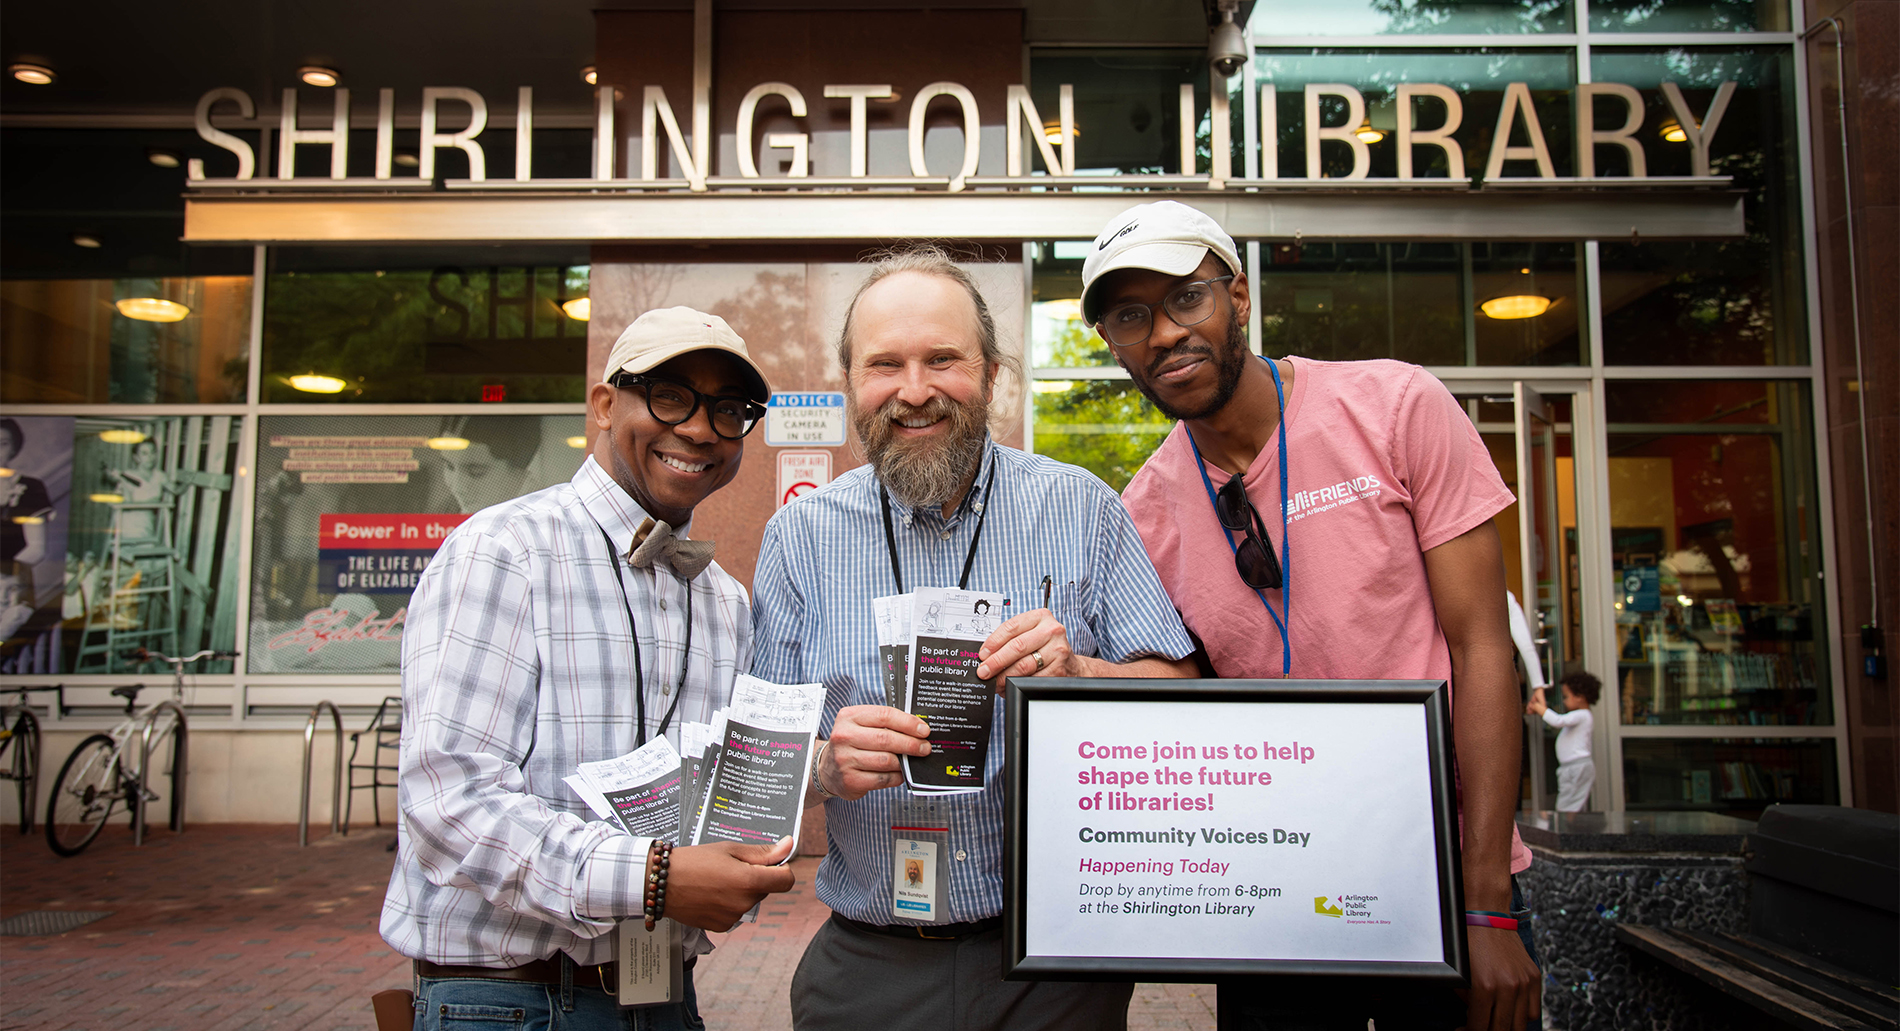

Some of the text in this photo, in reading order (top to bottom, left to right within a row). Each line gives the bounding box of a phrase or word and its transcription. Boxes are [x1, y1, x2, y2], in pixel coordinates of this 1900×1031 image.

[188, 82, 1737, 184] SHIRLINGTON LIBRARY
[776, 395, 834, 406] NOTICE
[781, 409, 830, 418] SECURITY
[784, 421, 827, 429] CAMERA
[787, 432, 823, 440] IN USE
[794, 468, 814, 479] ZONE
[1308, 475, 1381, 506] FRIENDS
[1294, 511, 1305, 521] the
[1306, 502, 1338, 516] Arlington
[1338, 495, 1359, 506] Public
[1360, 489, 1381, 500] Library
[334, 522, 395, 539] Power
[401, 523, 419, 538] in
[348, 556, 432, 571] THE LIFE AN
[338, 573, 421, 588] OF ELIZABE
[921, 646, 979, 659] Be part of shap
[921, 656, 980, 667] the future of th
[920, 666, 968, 677] public library
[731, 730, 742, 740] Be
[742, 736, 760, 746] part
[770, 741, 802, 751] shaping
[729, 740, 743, 750] the
[744, 744, 770, 756] future
[781, 750, 794, 758] the
[1078, 740, 1315, 764] Come join us to help
[727, 749, 777, 767] public library
[723, 766, 743, 776] feedback
[1078, 766, 1272, 789] shape the future
[632, 795, 658, 806] future
[658, 790, 667, 798] of
[667, 785, 680, 794] the
[727, 786, 741, 794] future
[740, 784, 761, 792] concepts
[625, 793, 642, 802] part
[1078, 792, 1214, 811] of libraries!
[621, 797, 669, 816] public library
[1078, 827, 1311, 848] Community Voices Day
[1079, 858, 1230, 876] Happening Today
[1079, 884, 1282, 900] Drop by anytime from 6-8pm
[1079, 902, 1255, 918] at the Shirlington Library
[1346, 910, 1371, 918] Library
